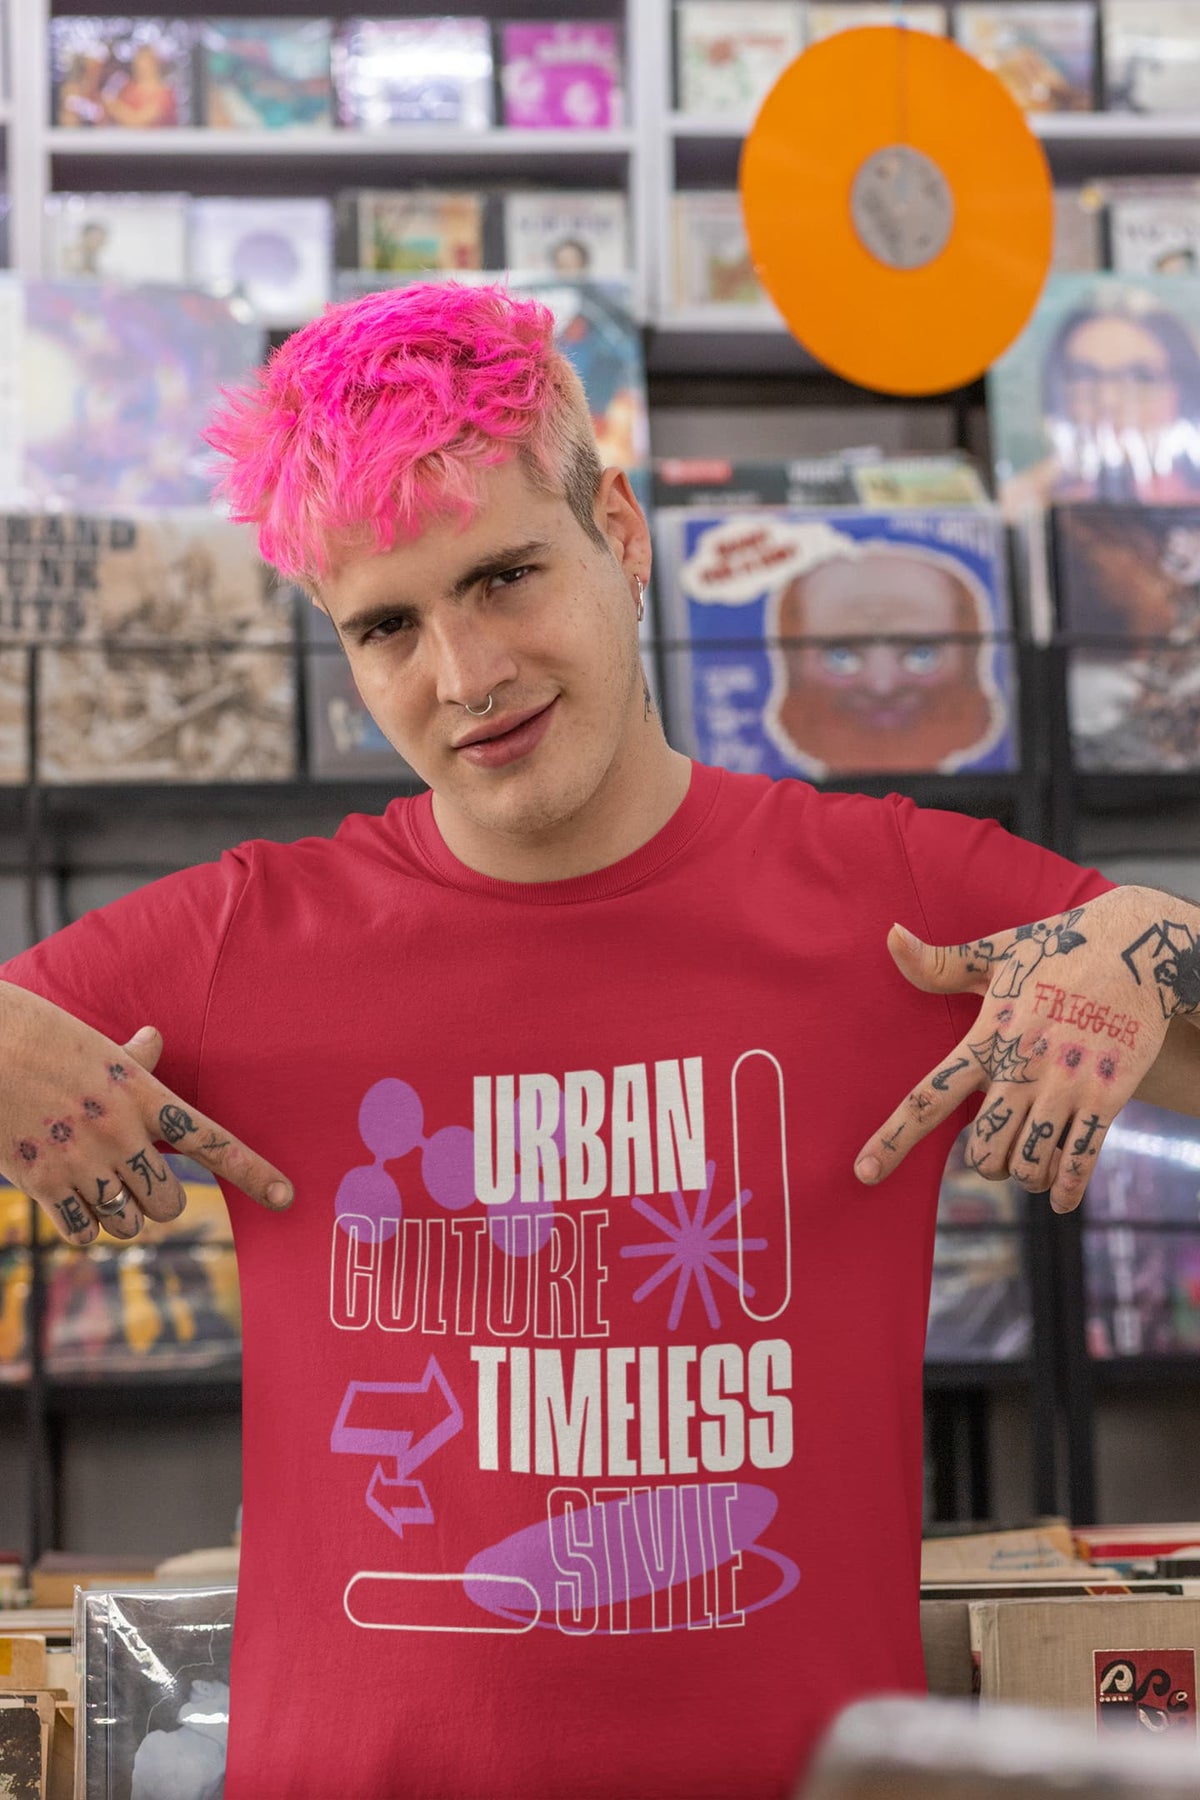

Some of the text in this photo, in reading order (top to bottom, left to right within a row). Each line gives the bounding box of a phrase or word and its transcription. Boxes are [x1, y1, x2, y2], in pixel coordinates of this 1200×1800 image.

[473, 1056, 707, 1205] URBAN
[330, 1209, 610, 1339] CULTURE
[470, 1338, 793, 1477] TIMELESS
[547, 1483, 745, 1636] STYLE
